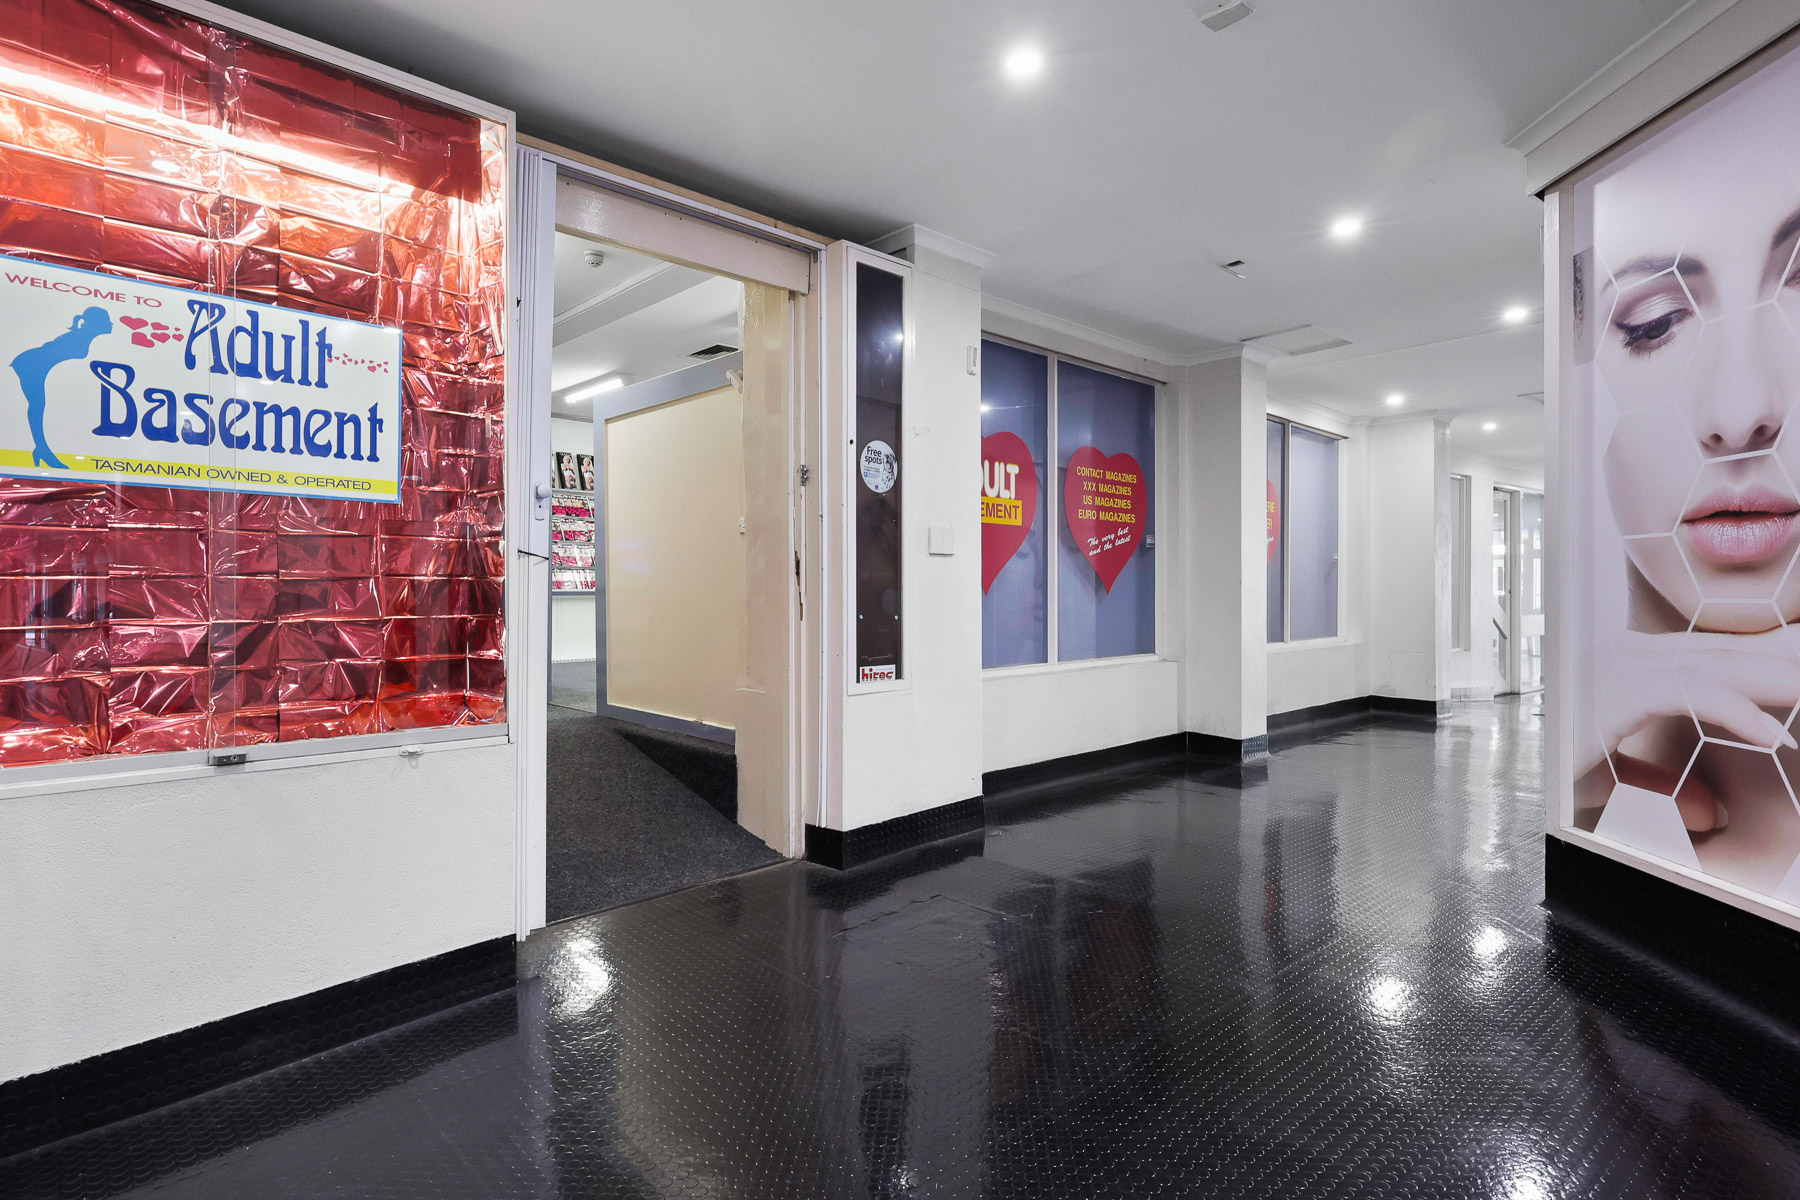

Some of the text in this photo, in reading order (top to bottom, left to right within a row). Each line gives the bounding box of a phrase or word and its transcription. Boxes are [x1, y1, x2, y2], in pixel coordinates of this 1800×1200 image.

[5, 272, 162, 308] WELCOME TO
[184, 299, 332, 389] Adult
[90, 360, 384, 463] Basement
[865, 455, 882, 465] spots
[867, 446, 882, 457] Free
[91, 458, 372, 491] TASMANIAN OWNED & OPERATED
[1076, 466, 1137, 484] CONTACT MAGAZINES
[1083, 481, 1132, 496] XXX MAGAZINES
[1083, 494, 1131, 509] US MAGAZINES
[1078, 508, 1136, 523] EURO MAGAZINES
[1087, 526, 1129, 547] The very best
[1089, 534, 1131, 556] and the latest
